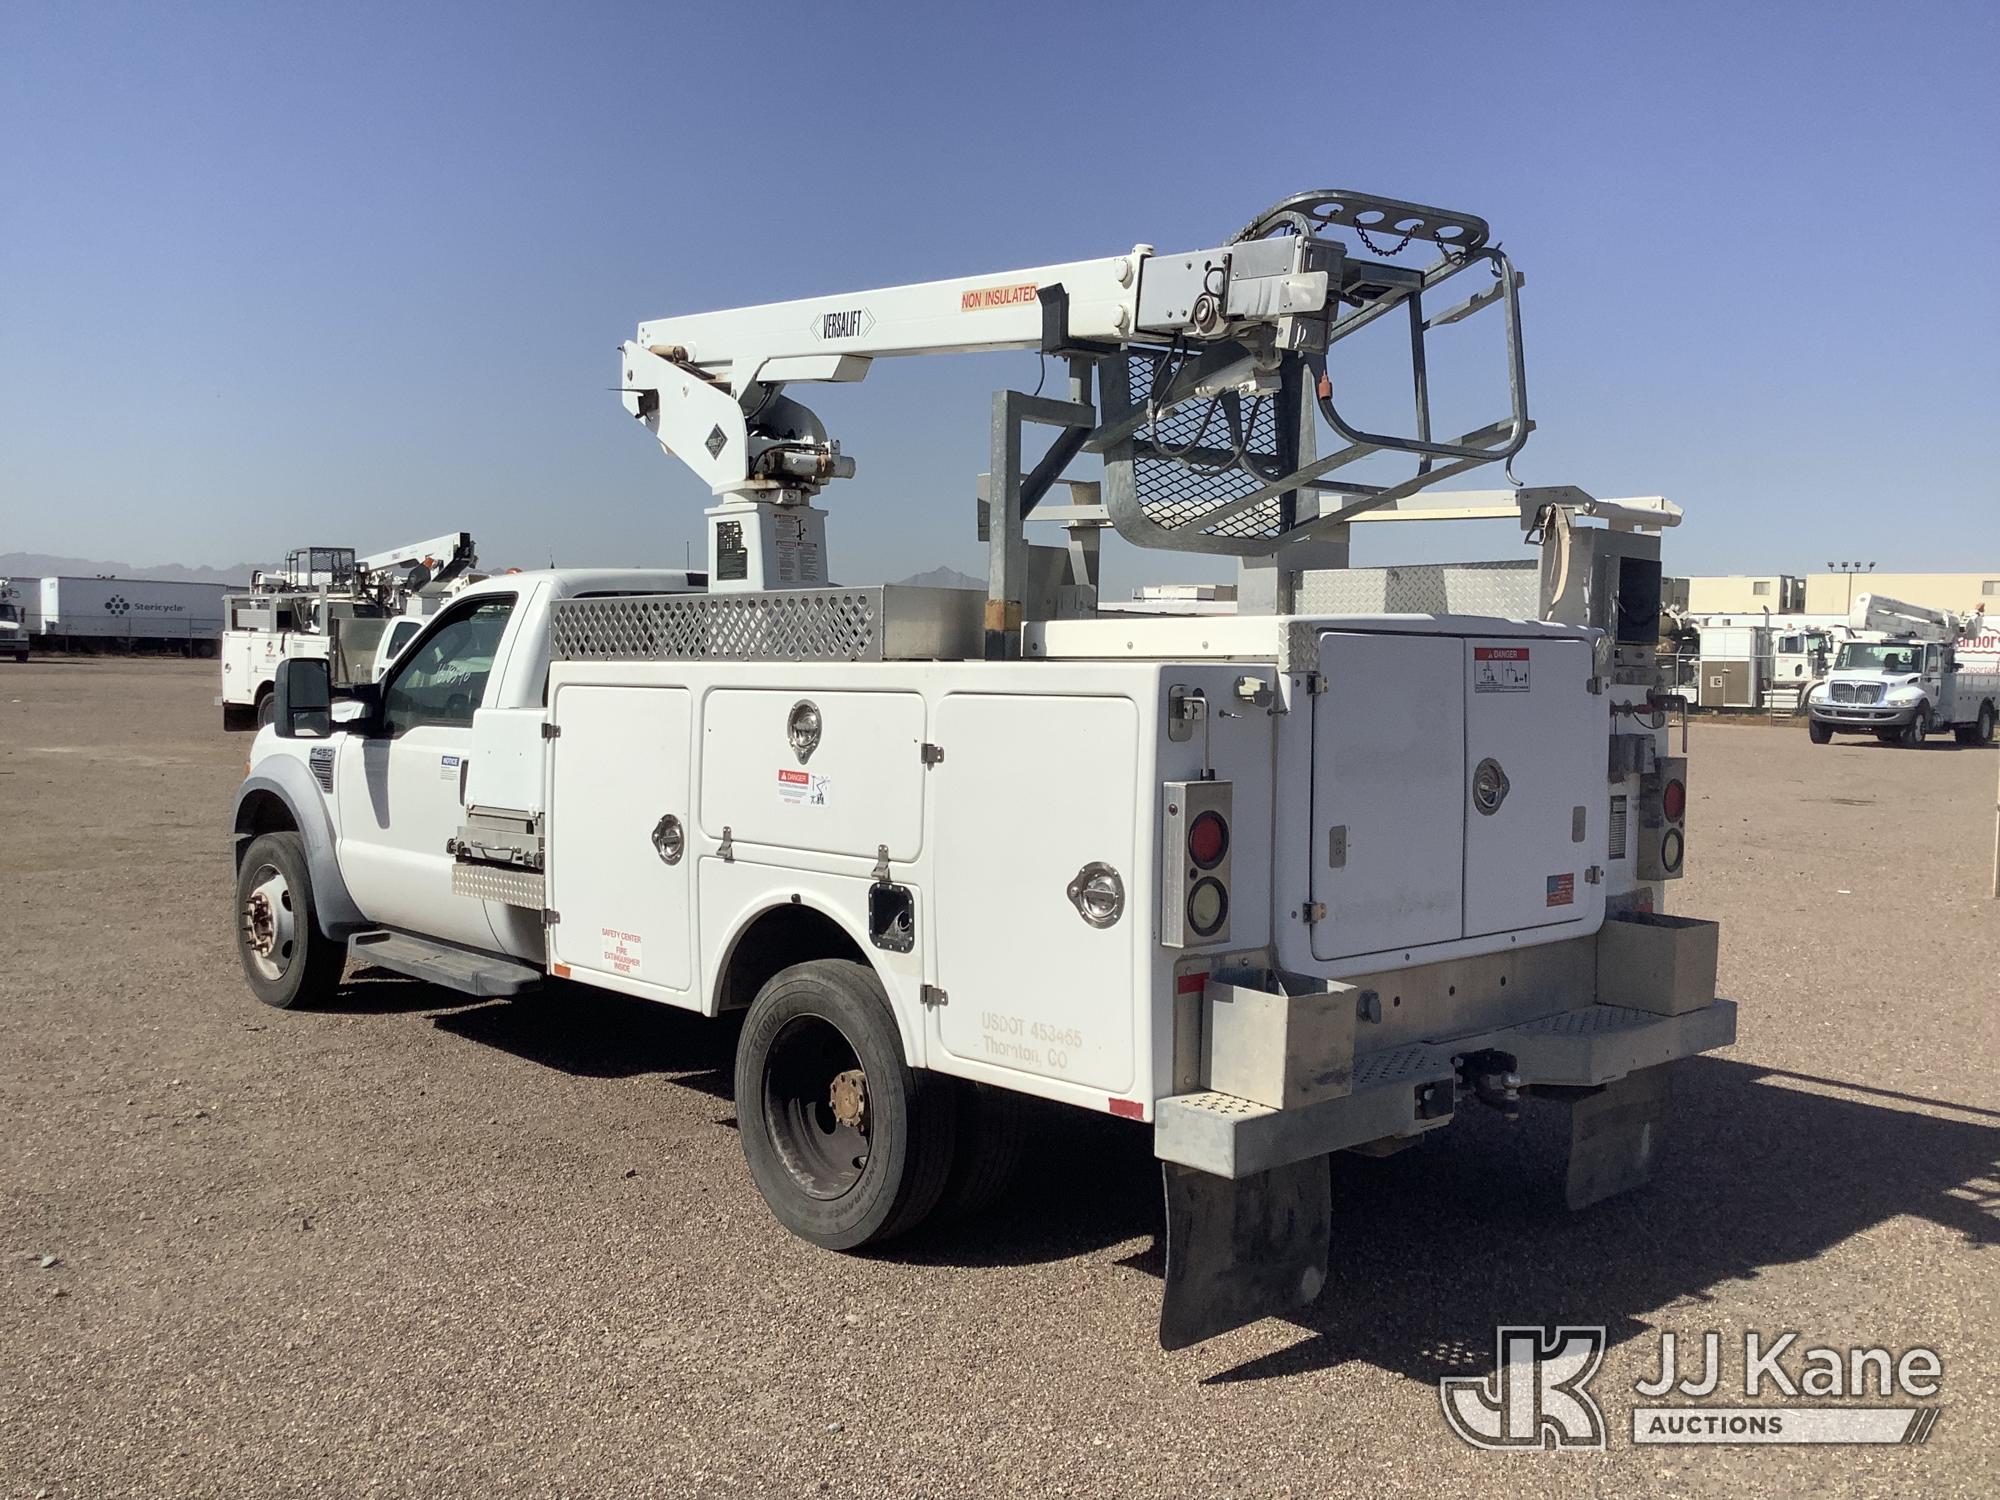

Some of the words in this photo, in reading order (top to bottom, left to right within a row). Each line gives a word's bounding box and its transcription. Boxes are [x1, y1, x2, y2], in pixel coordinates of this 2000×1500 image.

[961, 292, 982, 309] NON
[984, 285, 1037, 306] INSULATED
[823, 309, 863, 339] VERSALIFT
[134, 602, 185, 613] Stericycle
[601, 927, 620, 938] SAFETY
[620, 931, 642, 944] CENTER
[981, 1011, 1025, 1037] USDOT
[1047, 1046, 1069, 1069] CO
